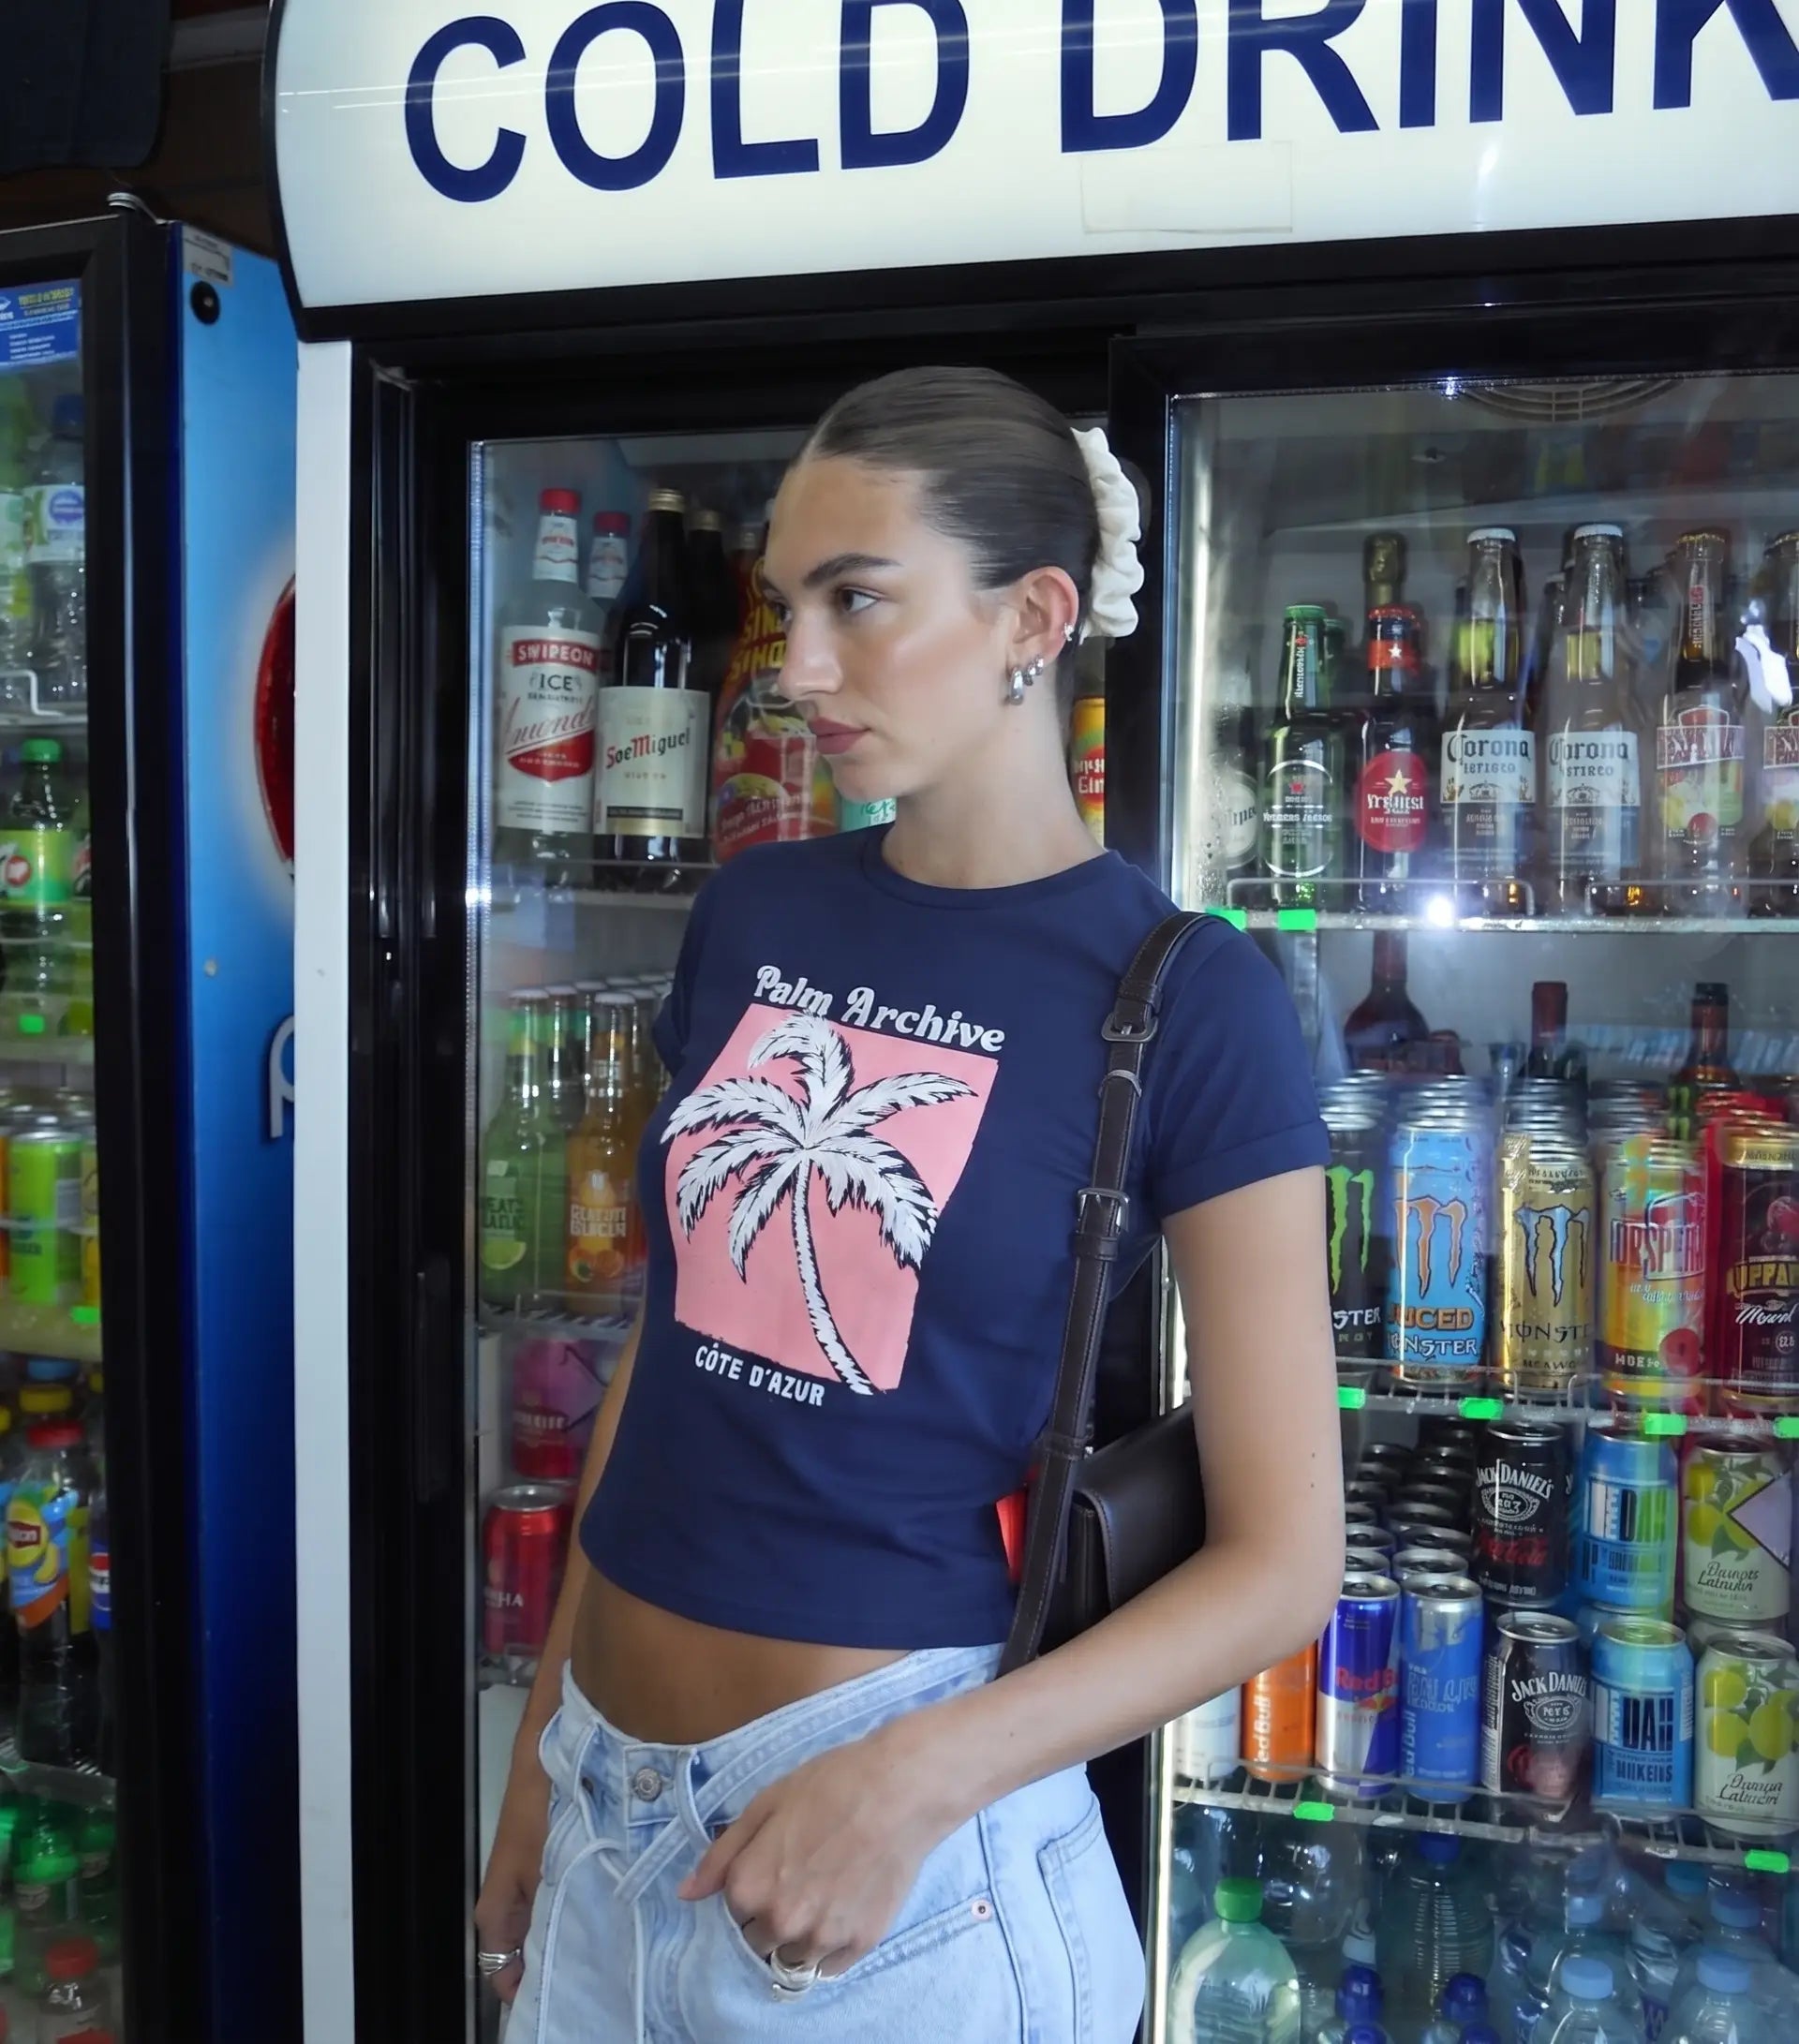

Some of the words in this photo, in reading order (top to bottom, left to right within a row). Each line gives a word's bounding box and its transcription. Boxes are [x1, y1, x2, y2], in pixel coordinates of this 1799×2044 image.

[405, 0, 970, 202] COLD
[540, 673, 573, 691] ICE
[1447, 733, 1532, 763] Corona
[753, 965, 833, 1016] Palm
[840, 986, 1005, 1053] Archive
[749, 1364, 825, 1407] D'AZUR
[1510, 1678, 1546, 1703] JACK
